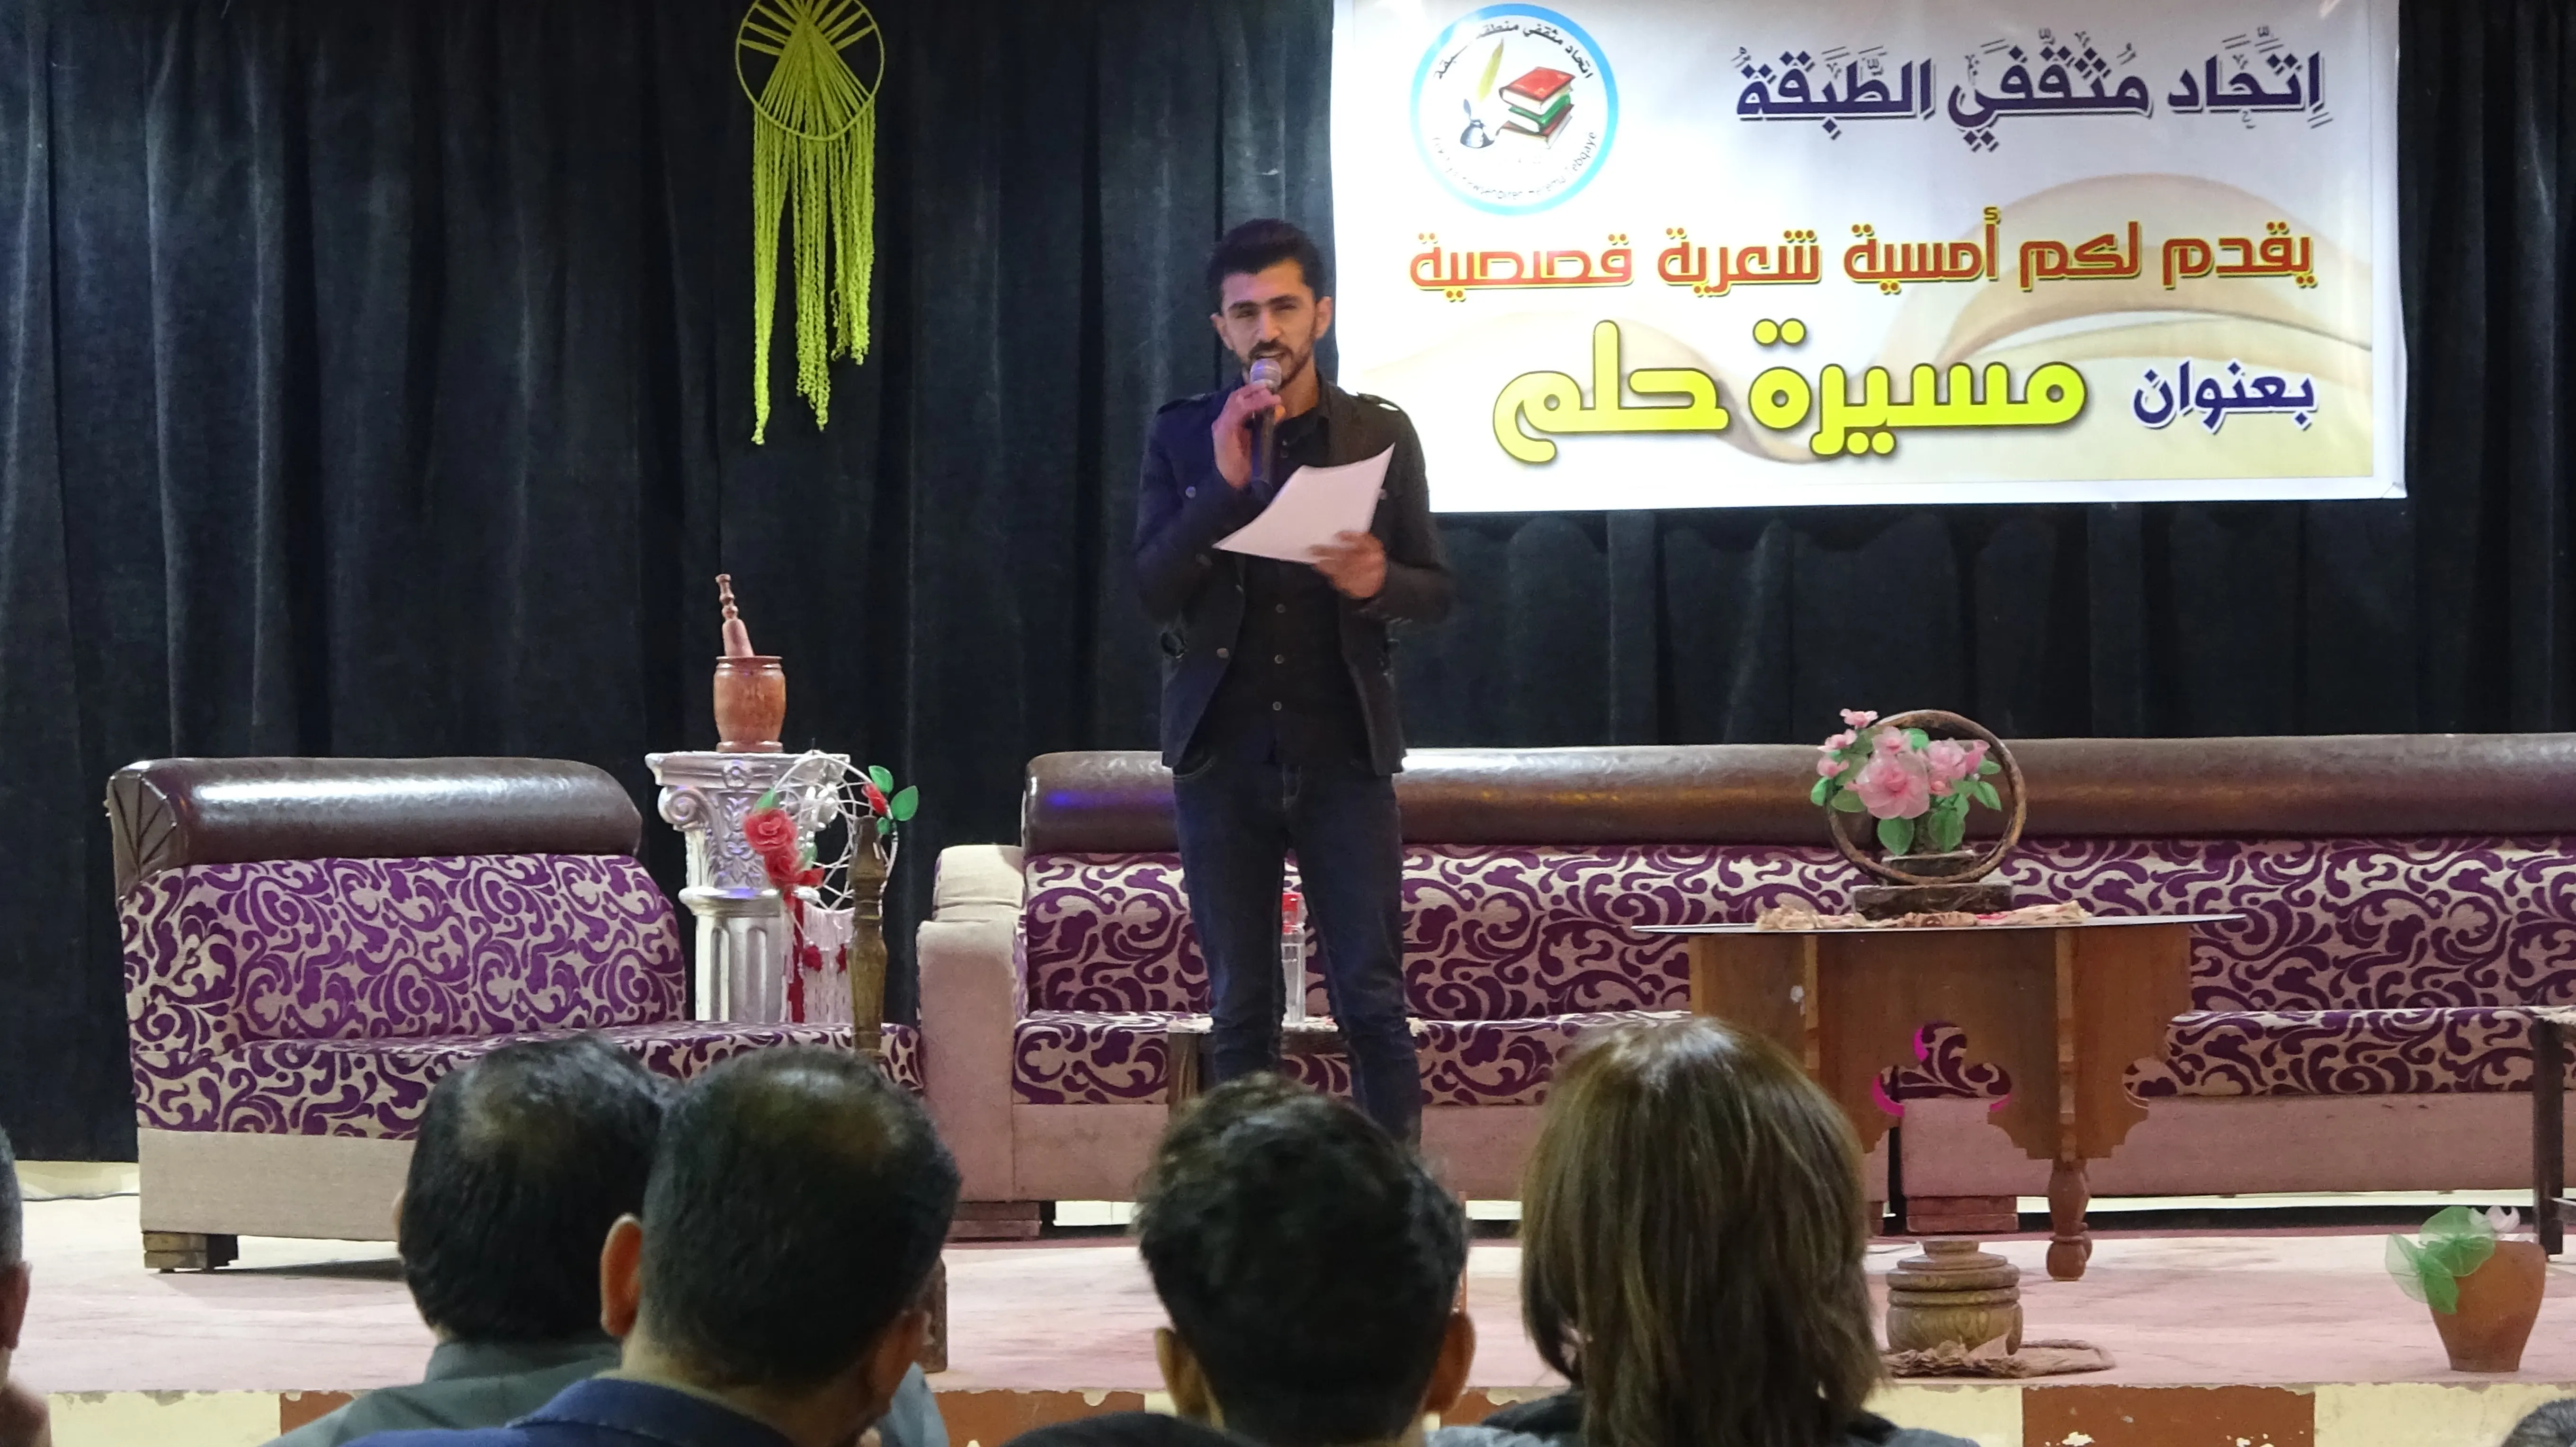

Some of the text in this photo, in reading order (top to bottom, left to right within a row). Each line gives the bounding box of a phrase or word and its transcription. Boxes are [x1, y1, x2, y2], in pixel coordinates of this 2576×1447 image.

[1522, 23, 1564, 45] مثقفي
[1565, 45, 1594, 79] اتحاد
[1410, 206, 2317, 301] يقدم لكم أمسية شعرية قصصية
[1493, 318, 2317, 463] بعنوان مسيرة حلم
